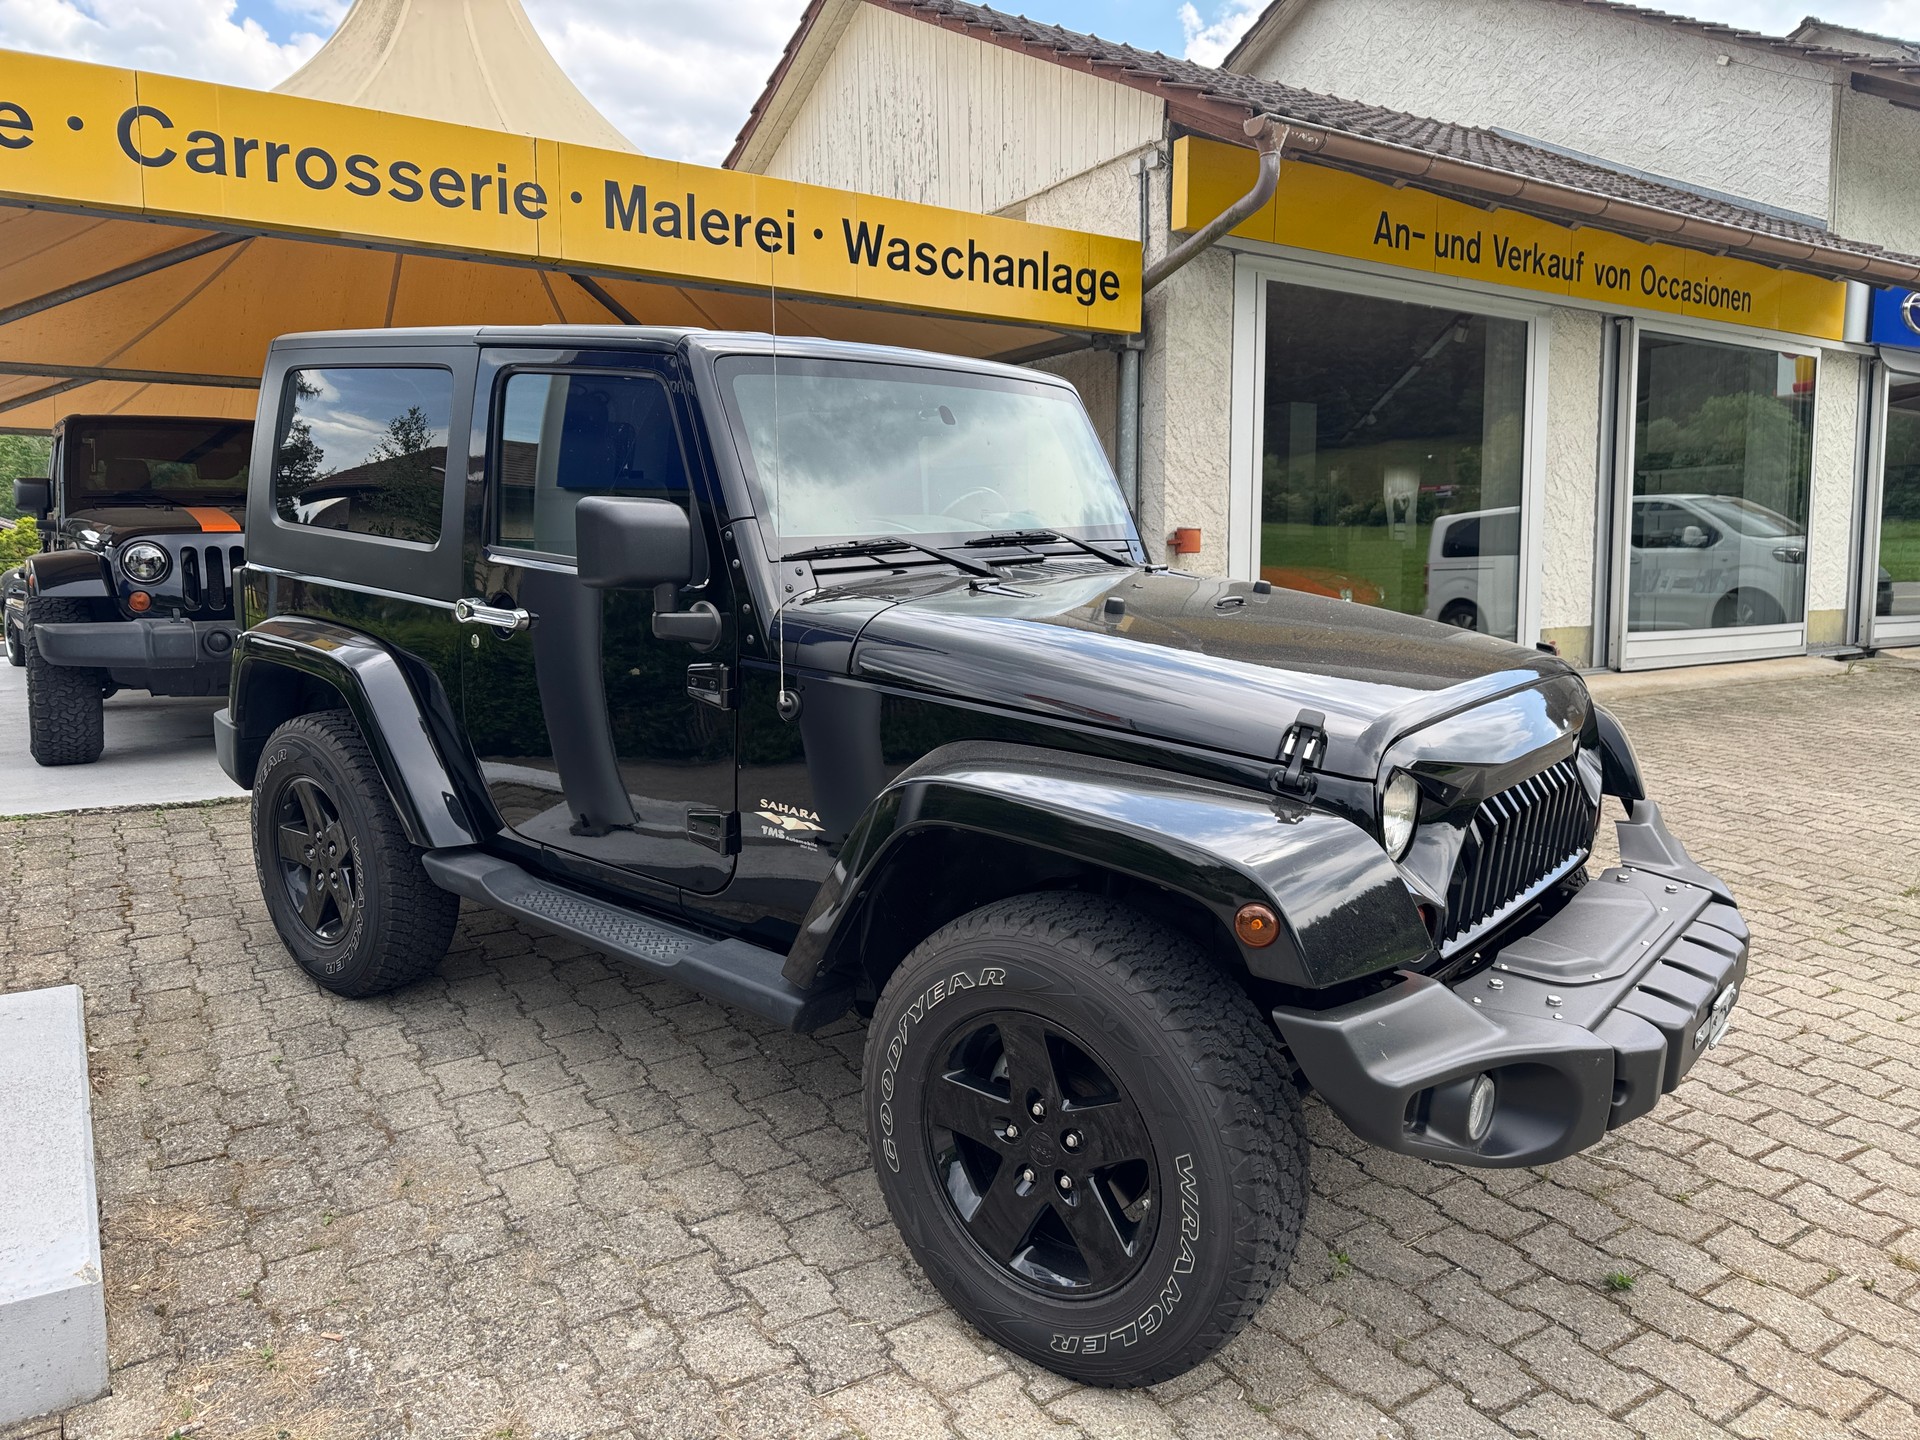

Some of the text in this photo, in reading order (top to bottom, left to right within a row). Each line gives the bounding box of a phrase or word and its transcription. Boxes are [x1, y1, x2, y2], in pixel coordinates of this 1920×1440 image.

[116, 105, 548, 220] Carrosserie
[604, 179, 795, 256] Malerei
[842, 217, 1121, 307] Waschanlage
[1373, 210, 1752, 313] An- und Verkauf von Occasionen
[760, 798, 821, 822] SAHARA
[761, 825, 785, 839] TMS
[326, 836, 365, 975] WRANGLER
[880, 967, 1006, 1173] GOODYEAR
[1051, 1153, 1200, 1355] WRANGLER
